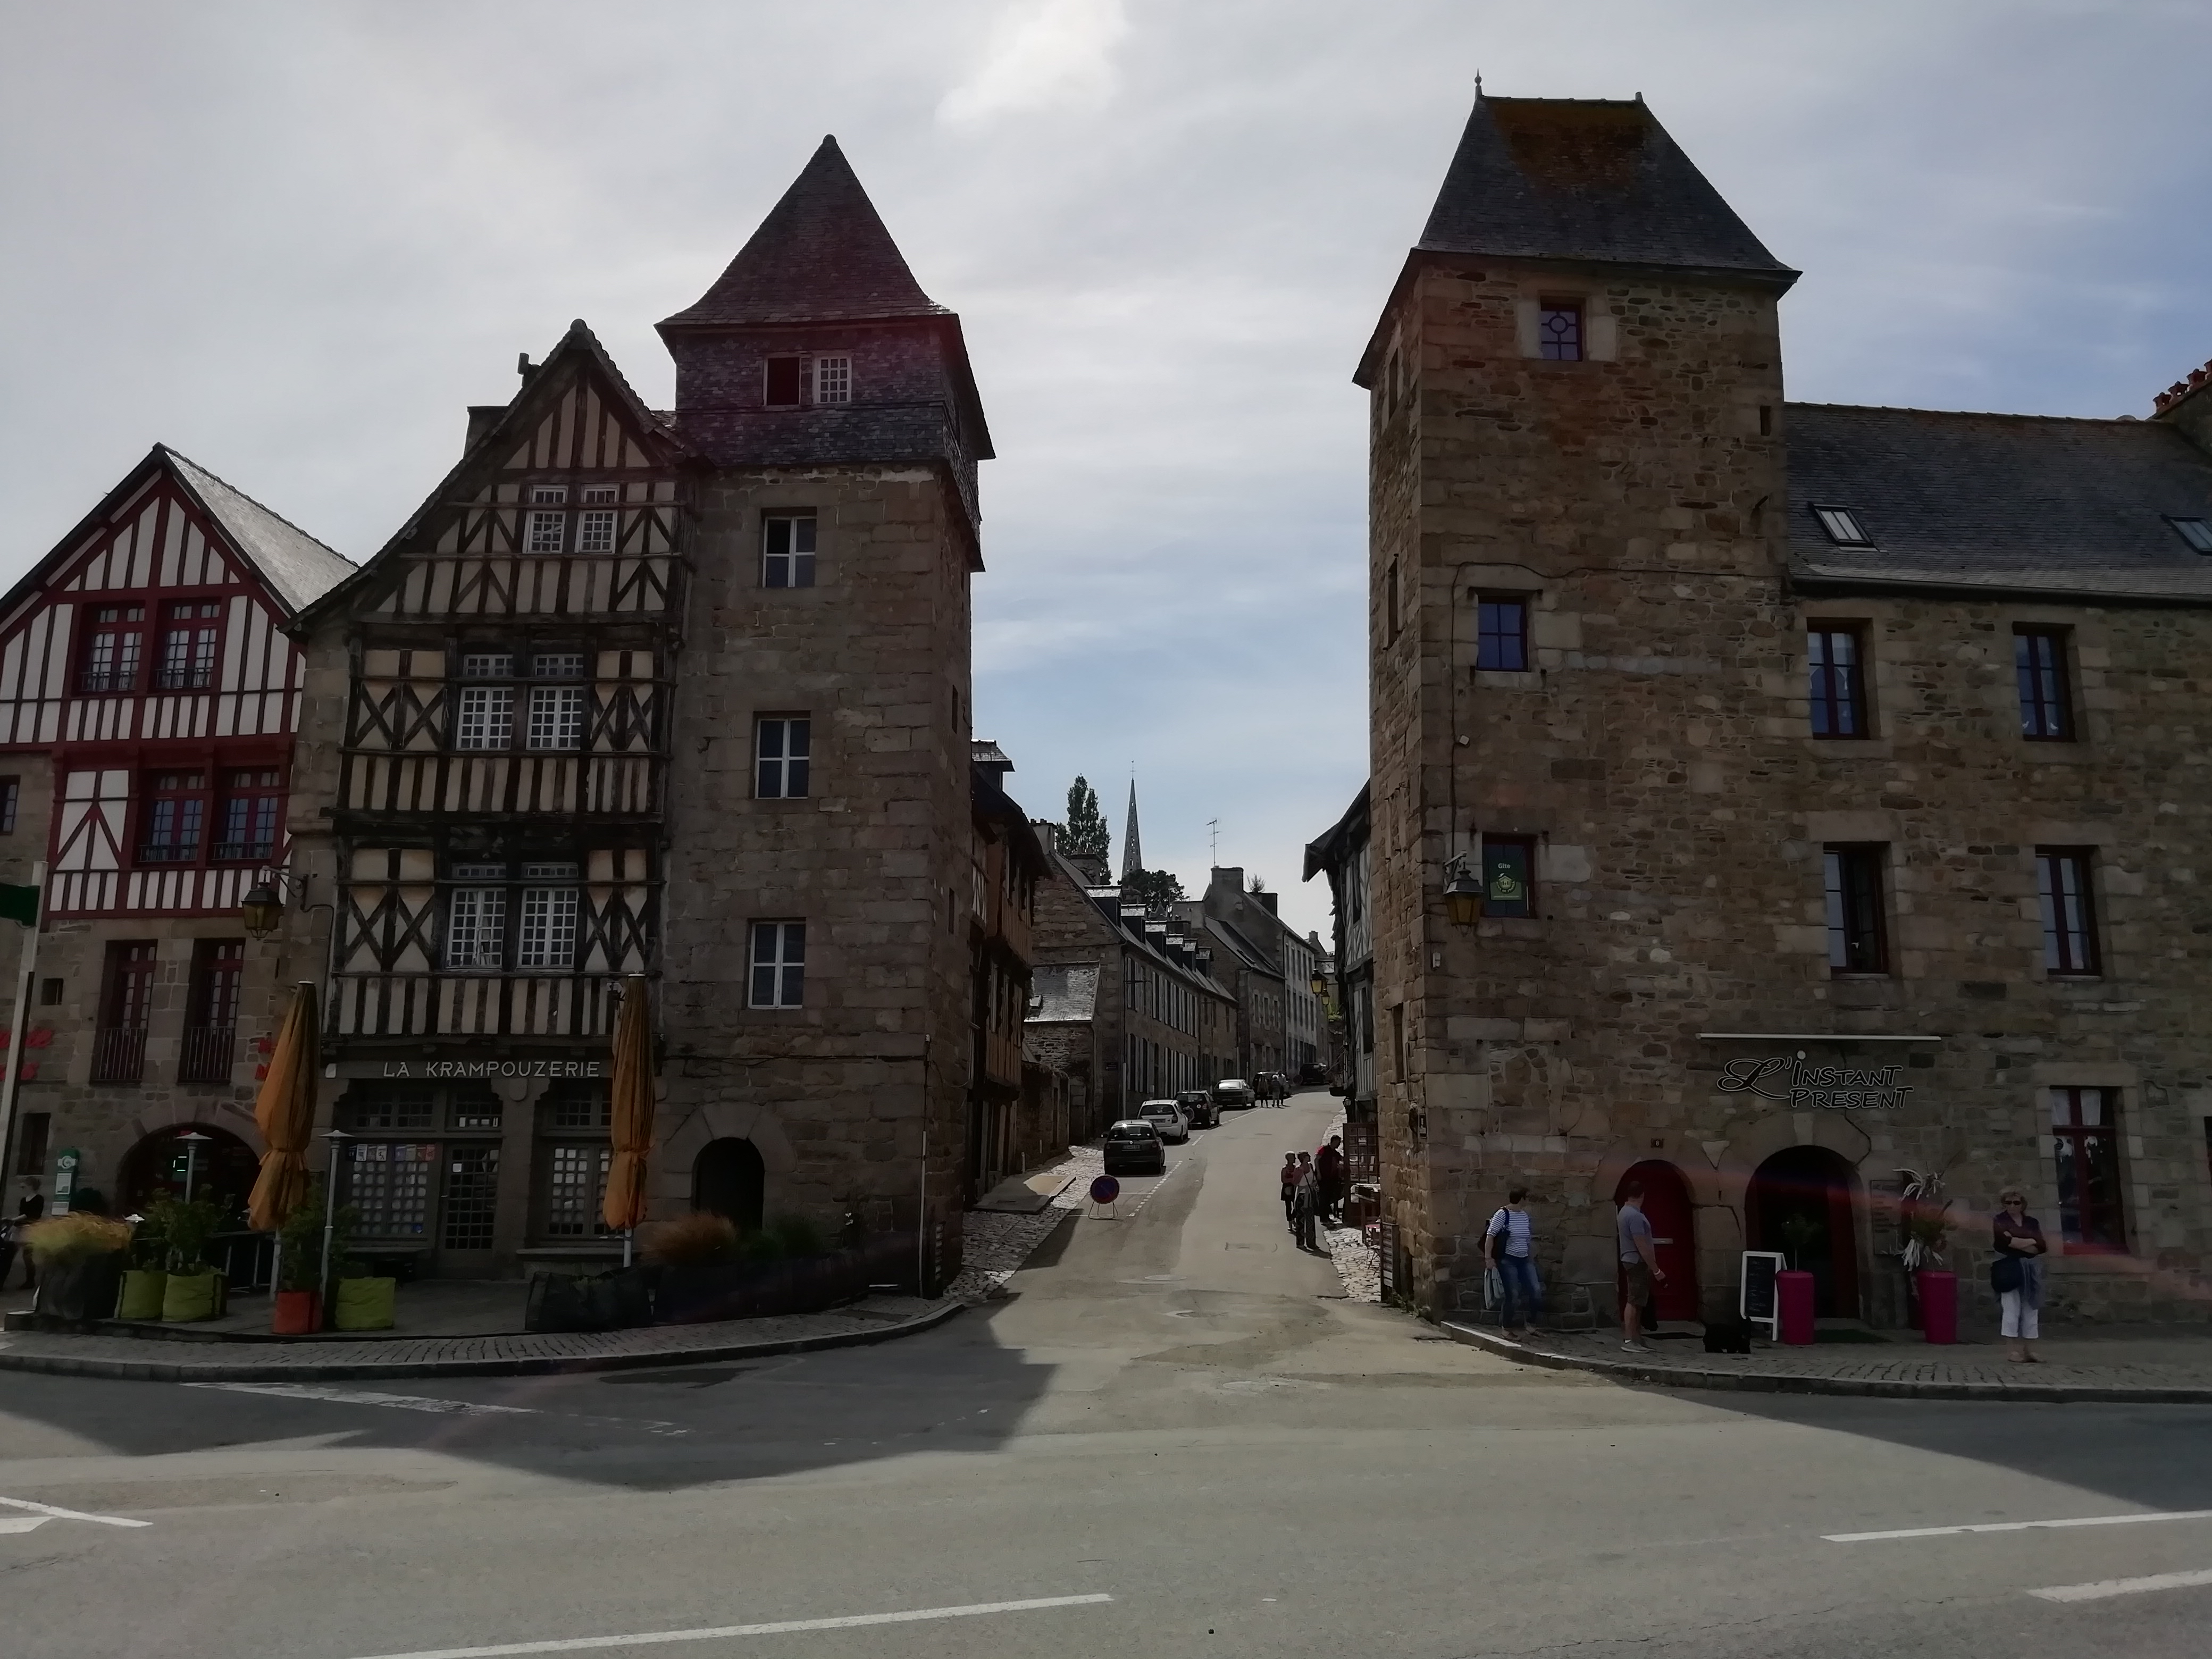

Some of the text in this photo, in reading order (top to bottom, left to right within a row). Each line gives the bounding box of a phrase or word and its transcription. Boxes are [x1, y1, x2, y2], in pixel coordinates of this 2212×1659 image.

[383, 1061, 600, 1078] LA KRAMPOUZERIE
[1789, 1086, 1914, 1109] PRESENT
